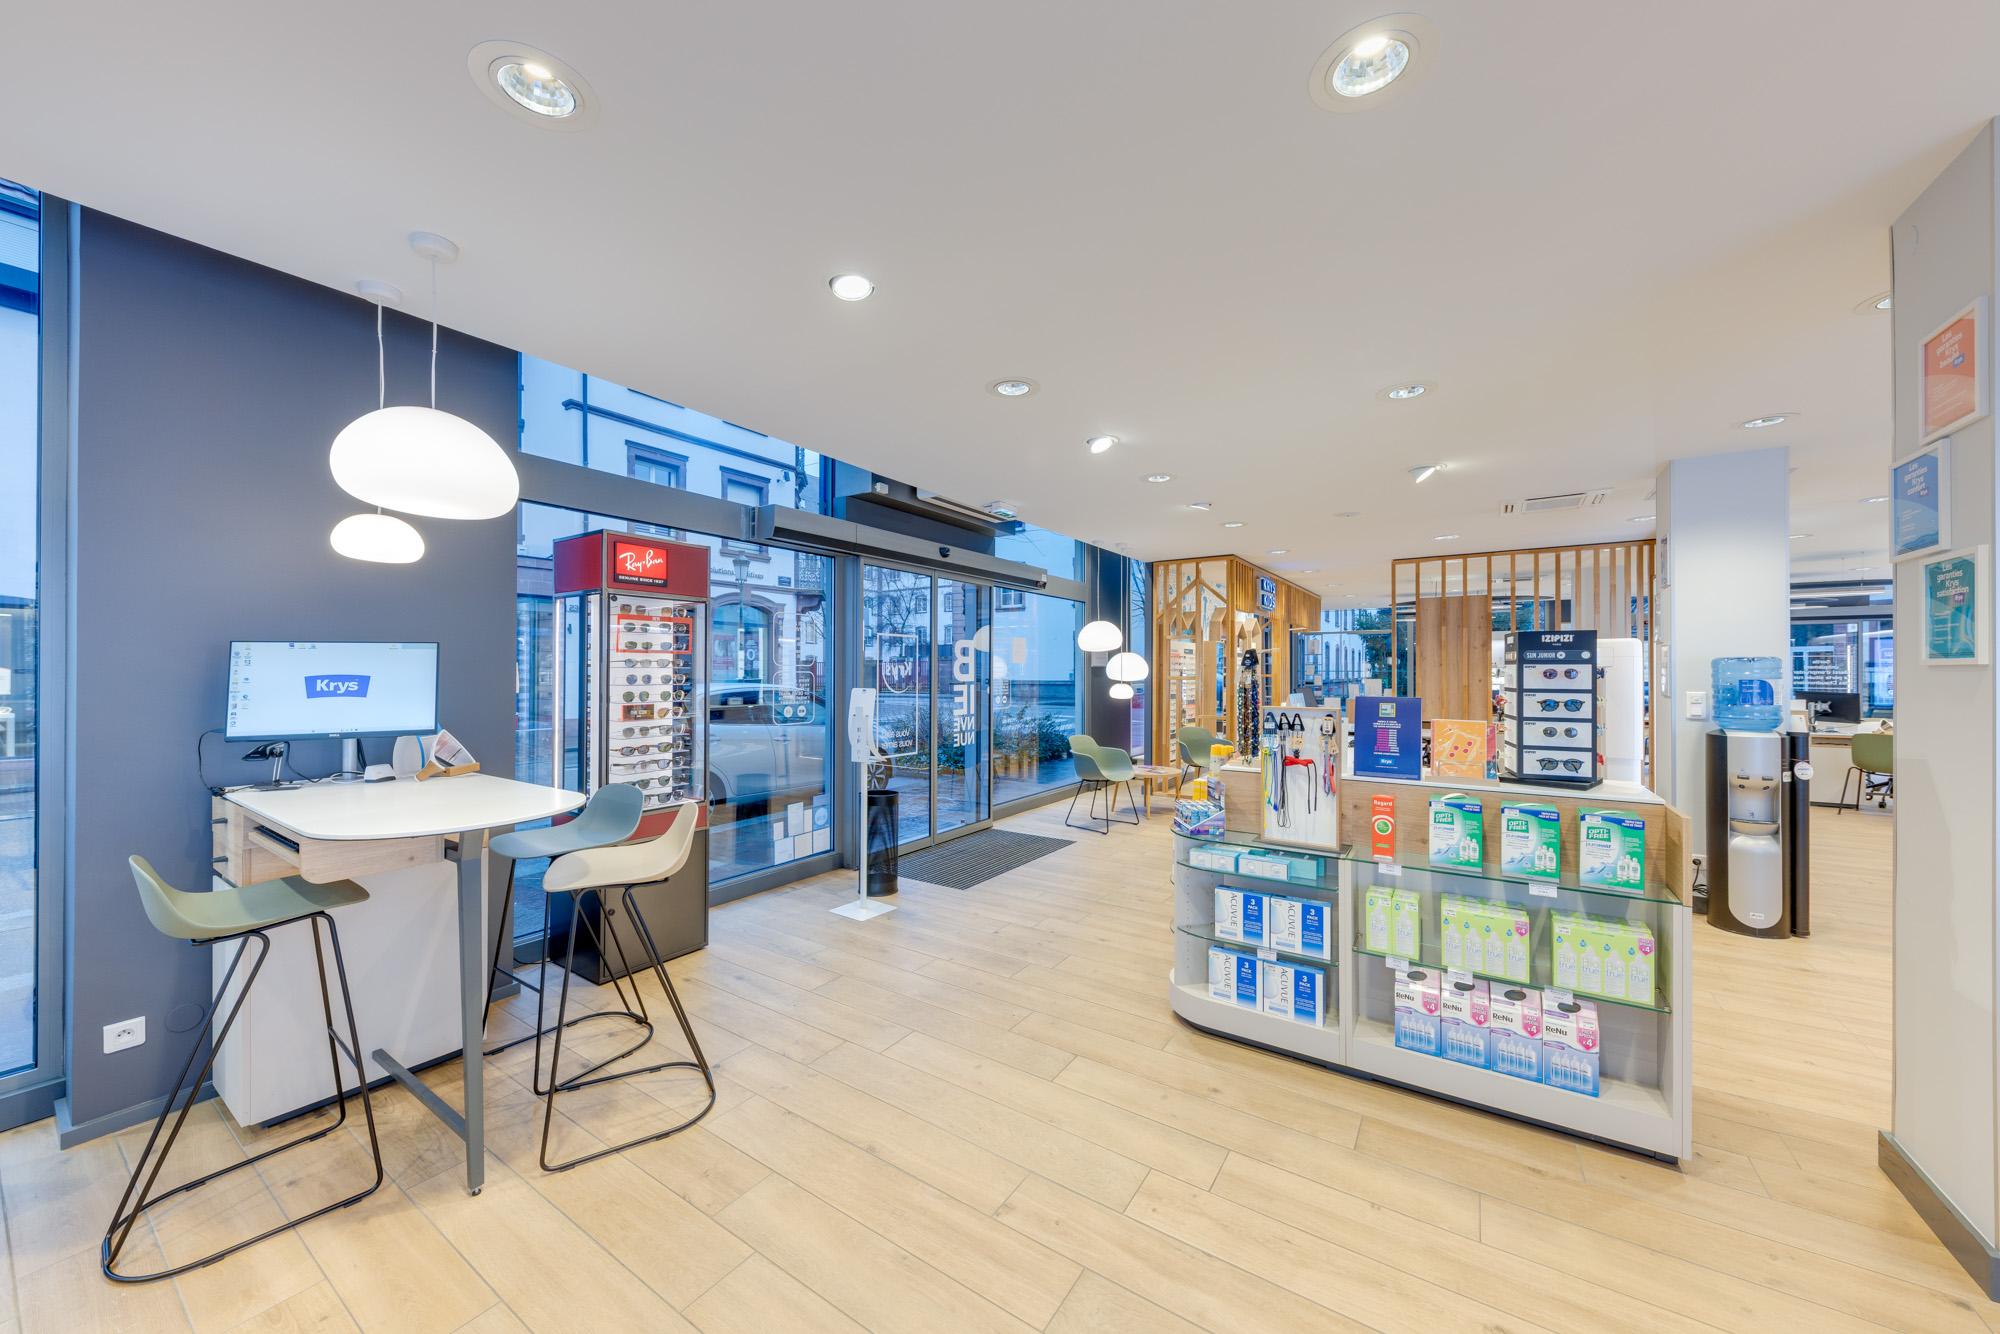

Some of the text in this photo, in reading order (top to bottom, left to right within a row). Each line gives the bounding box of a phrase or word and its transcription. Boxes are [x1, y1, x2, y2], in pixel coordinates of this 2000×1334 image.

[316, 679, 358, 694] Krys
[1396, 992, 1414, 1001] ReNu
[1442, 1002, 1462, 1012] ReNu
[1492, 1013, 1513, 1023] ReNu
[1546, 1026, 1568, 1036] ReNu
